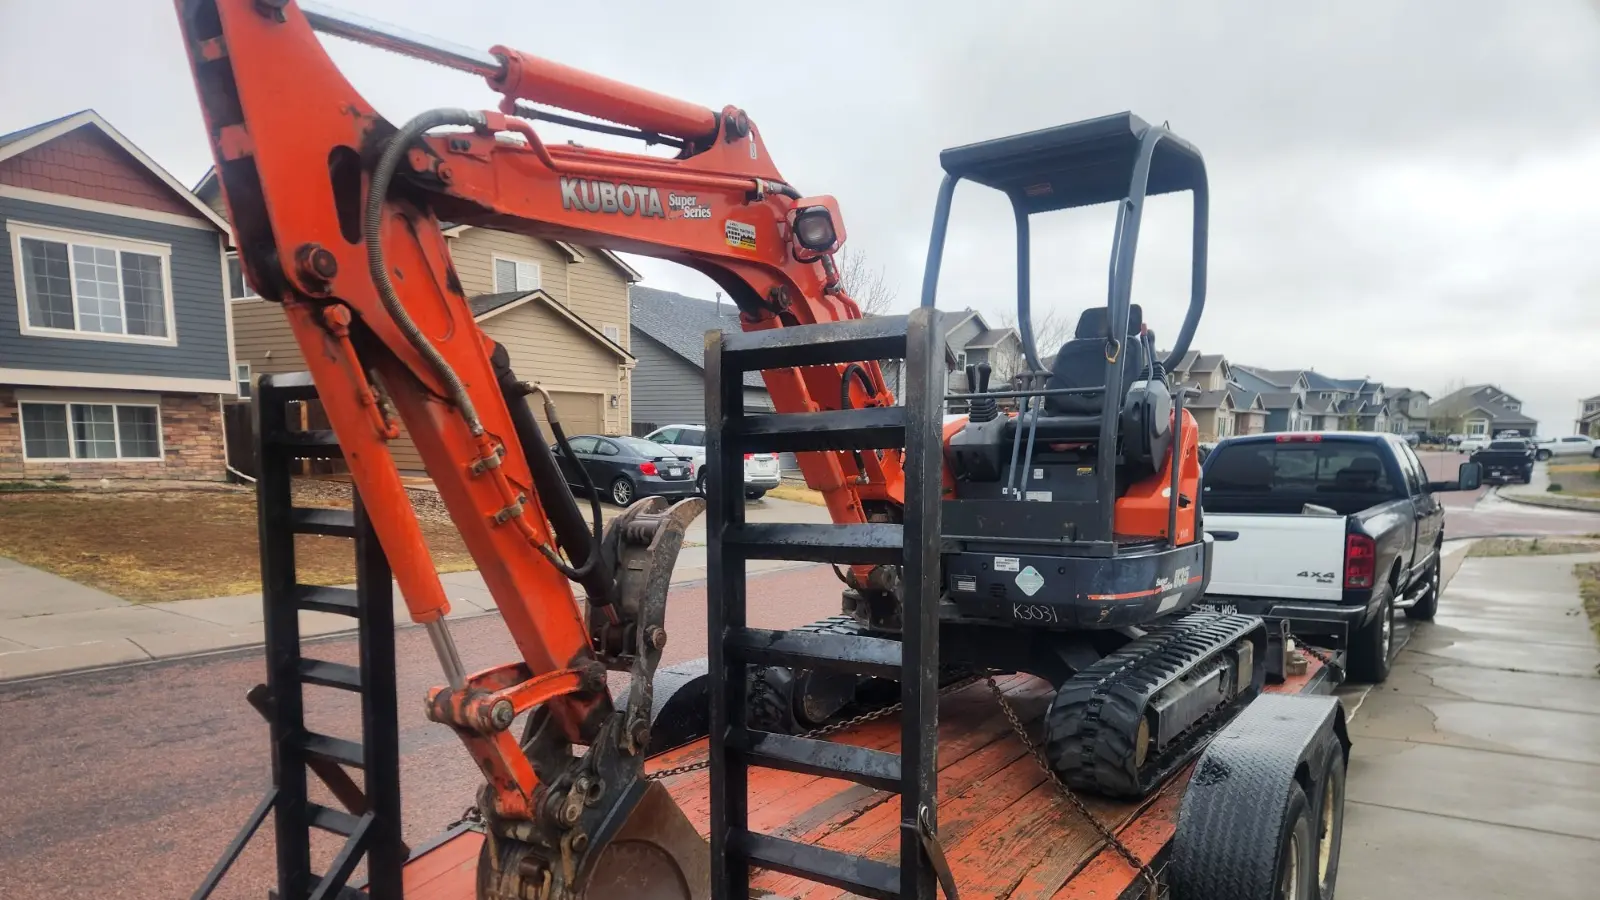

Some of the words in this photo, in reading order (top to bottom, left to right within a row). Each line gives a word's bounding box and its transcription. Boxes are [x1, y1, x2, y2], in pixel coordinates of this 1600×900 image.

[560, 176, 665, 218] KUBOTA
[669, 192, 697, 208] Super
[683, 205, 712, 219] Series
[1013, 602, 1058, 622] K3031
